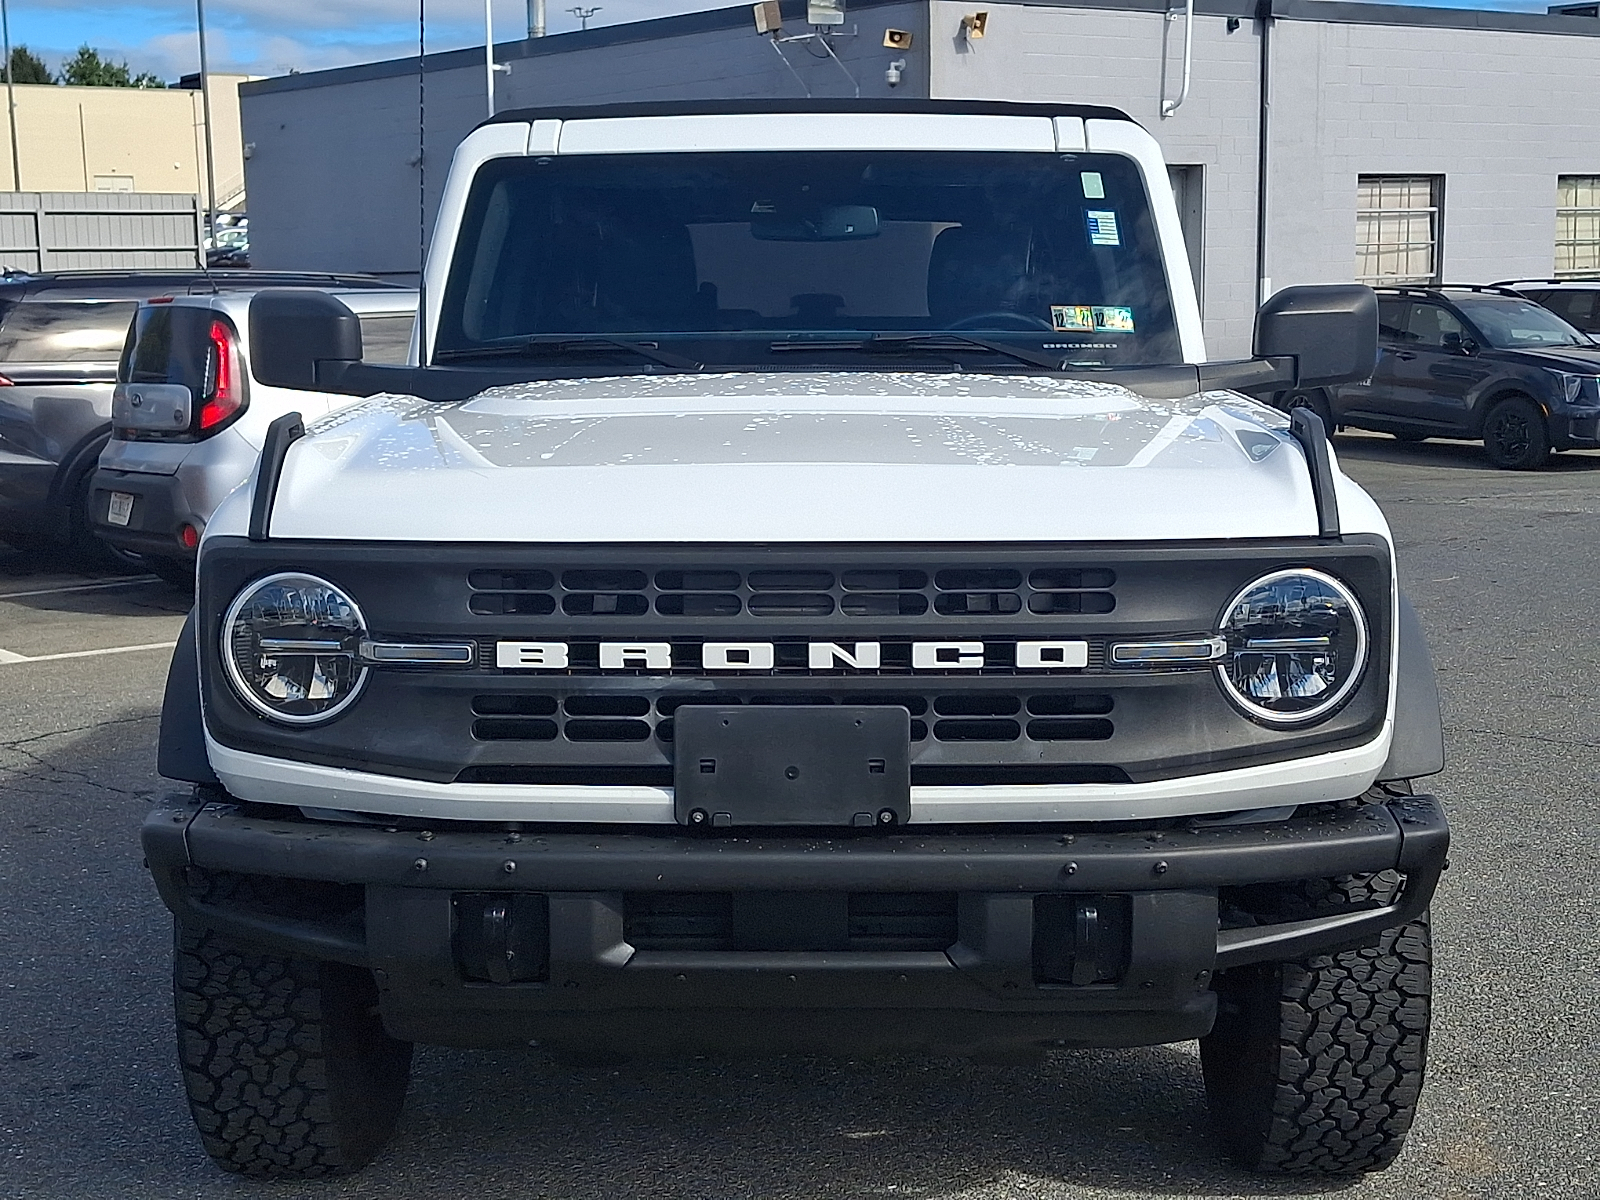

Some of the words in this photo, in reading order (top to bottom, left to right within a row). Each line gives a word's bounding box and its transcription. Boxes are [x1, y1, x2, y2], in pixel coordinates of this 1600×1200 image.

[1053, 312, 1066, 327] 12
[1094, 312, 1106, 327] 12
[497, 641, 1088, 669] BRONCO
